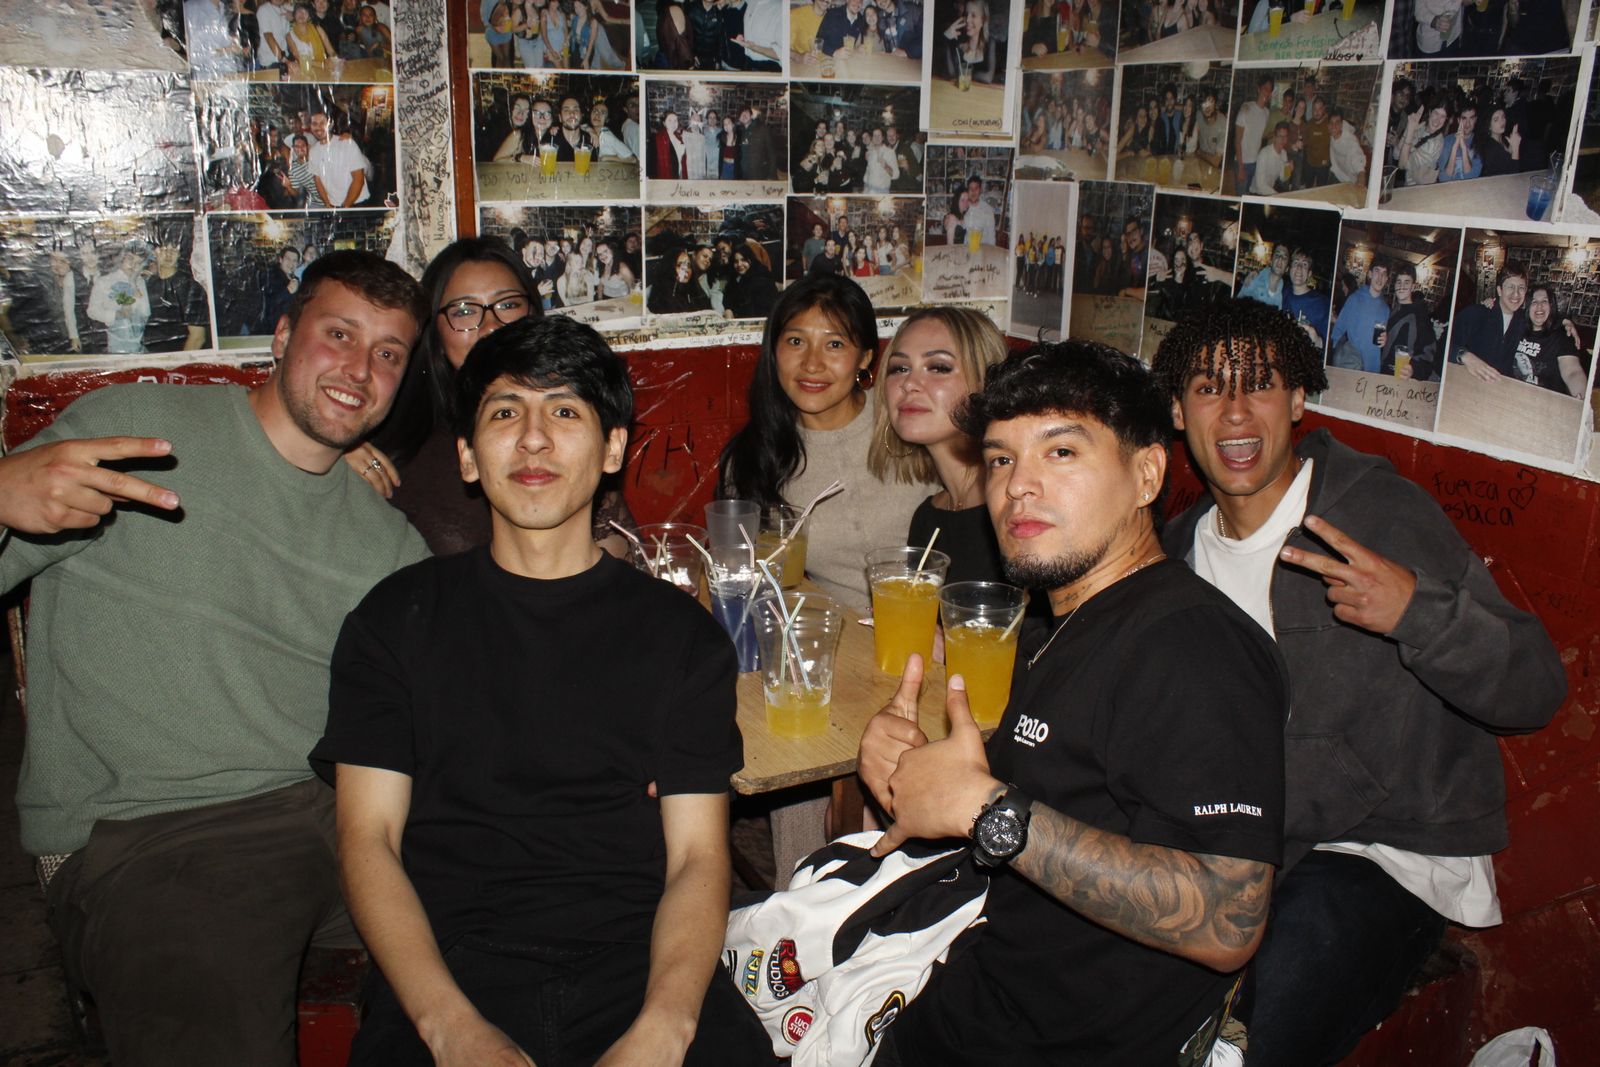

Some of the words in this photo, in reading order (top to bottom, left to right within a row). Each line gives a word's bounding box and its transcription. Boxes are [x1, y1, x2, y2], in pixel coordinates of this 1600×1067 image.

[1432, 470, 1499, 501] Fuerza
[1193, 803, 1229, 817] RALPH
[1229, 802, 1263, 818] LAUREN
[788, 1022, 807, 1037] STRI
